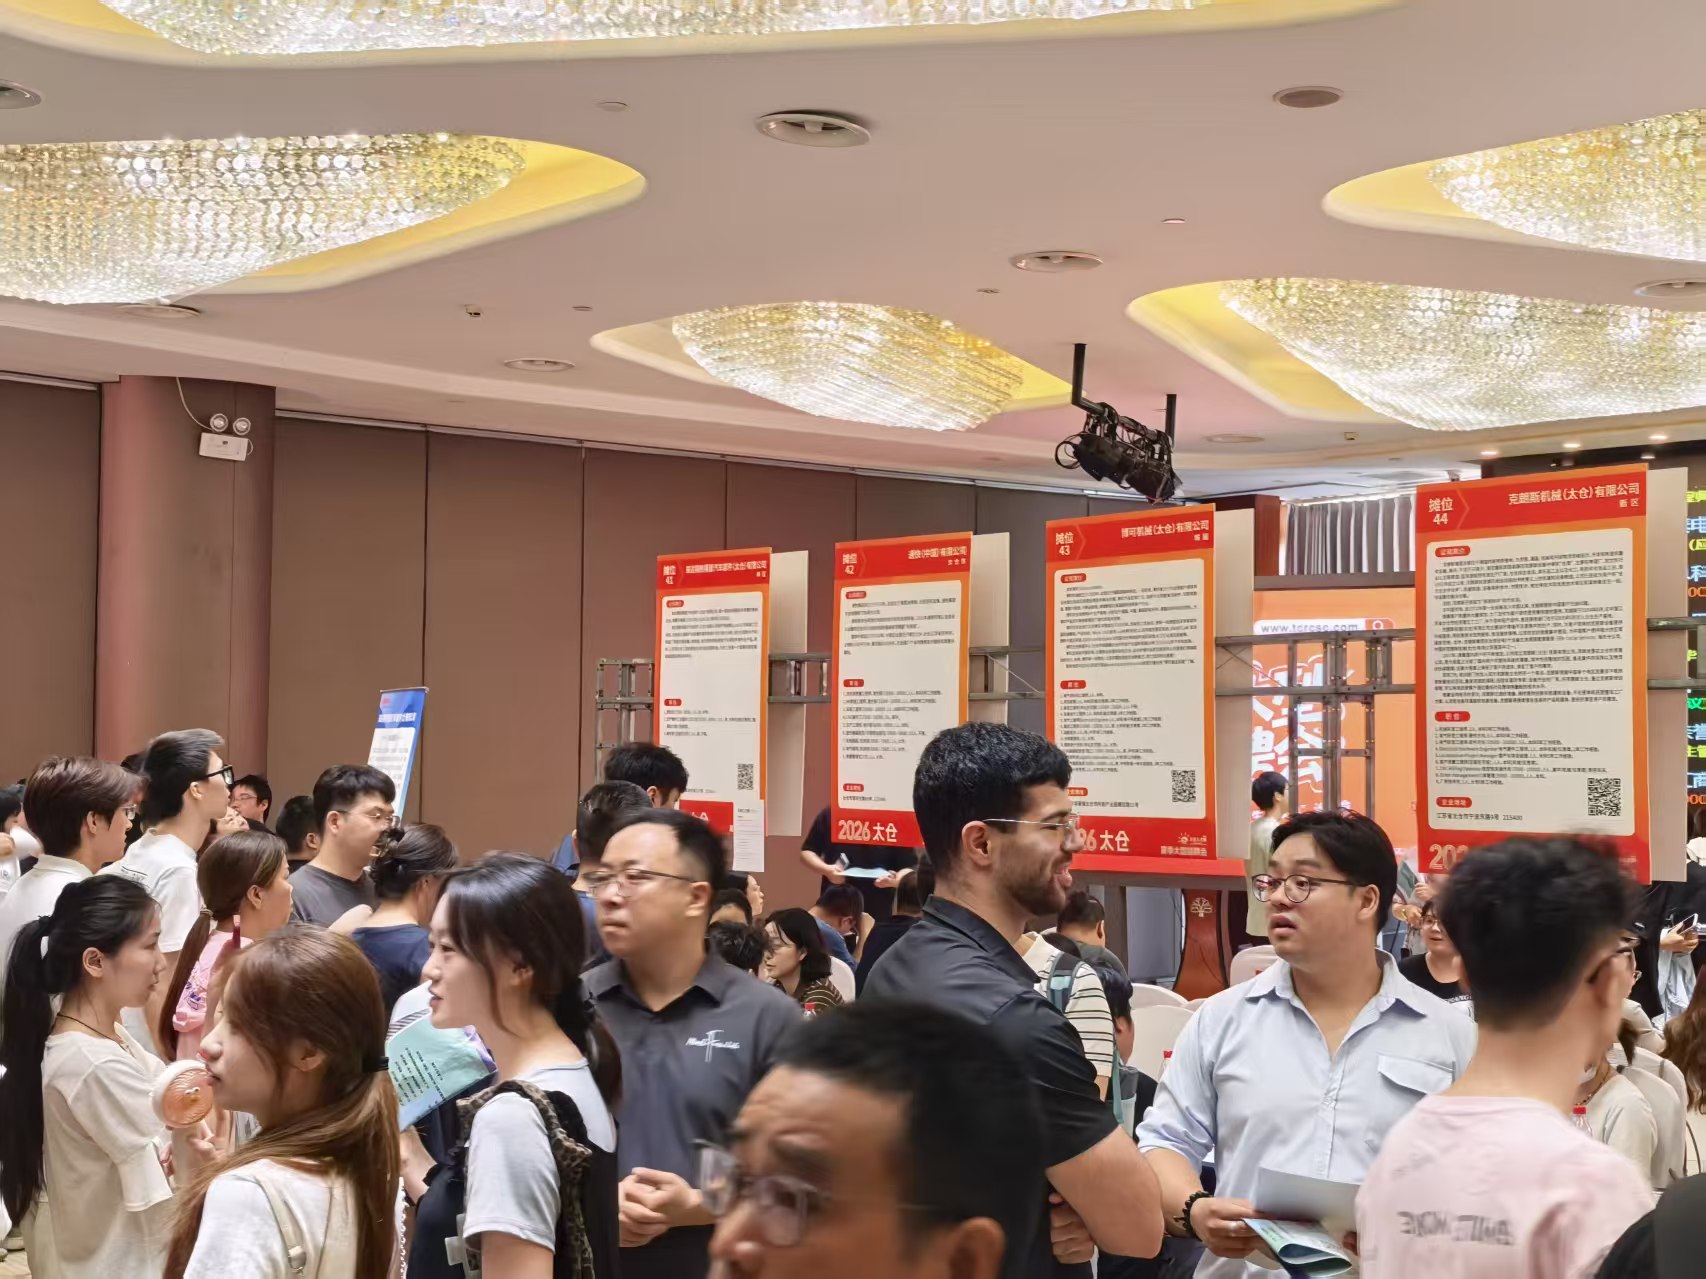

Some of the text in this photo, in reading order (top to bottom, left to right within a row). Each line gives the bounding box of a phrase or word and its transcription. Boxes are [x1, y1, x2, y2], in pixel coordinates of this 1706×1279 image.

[1508, 482, 1640, 505] 克朗斯机械(太仓)有限公司
[1433, 513, 1448, 525] 44
[1059, 545, 1071, 556] 43
[844, 565, 855, 575] 42
[838, 819, 898, 842] 2026 太仓
[1099, 829, 1130, 852] 太仓
